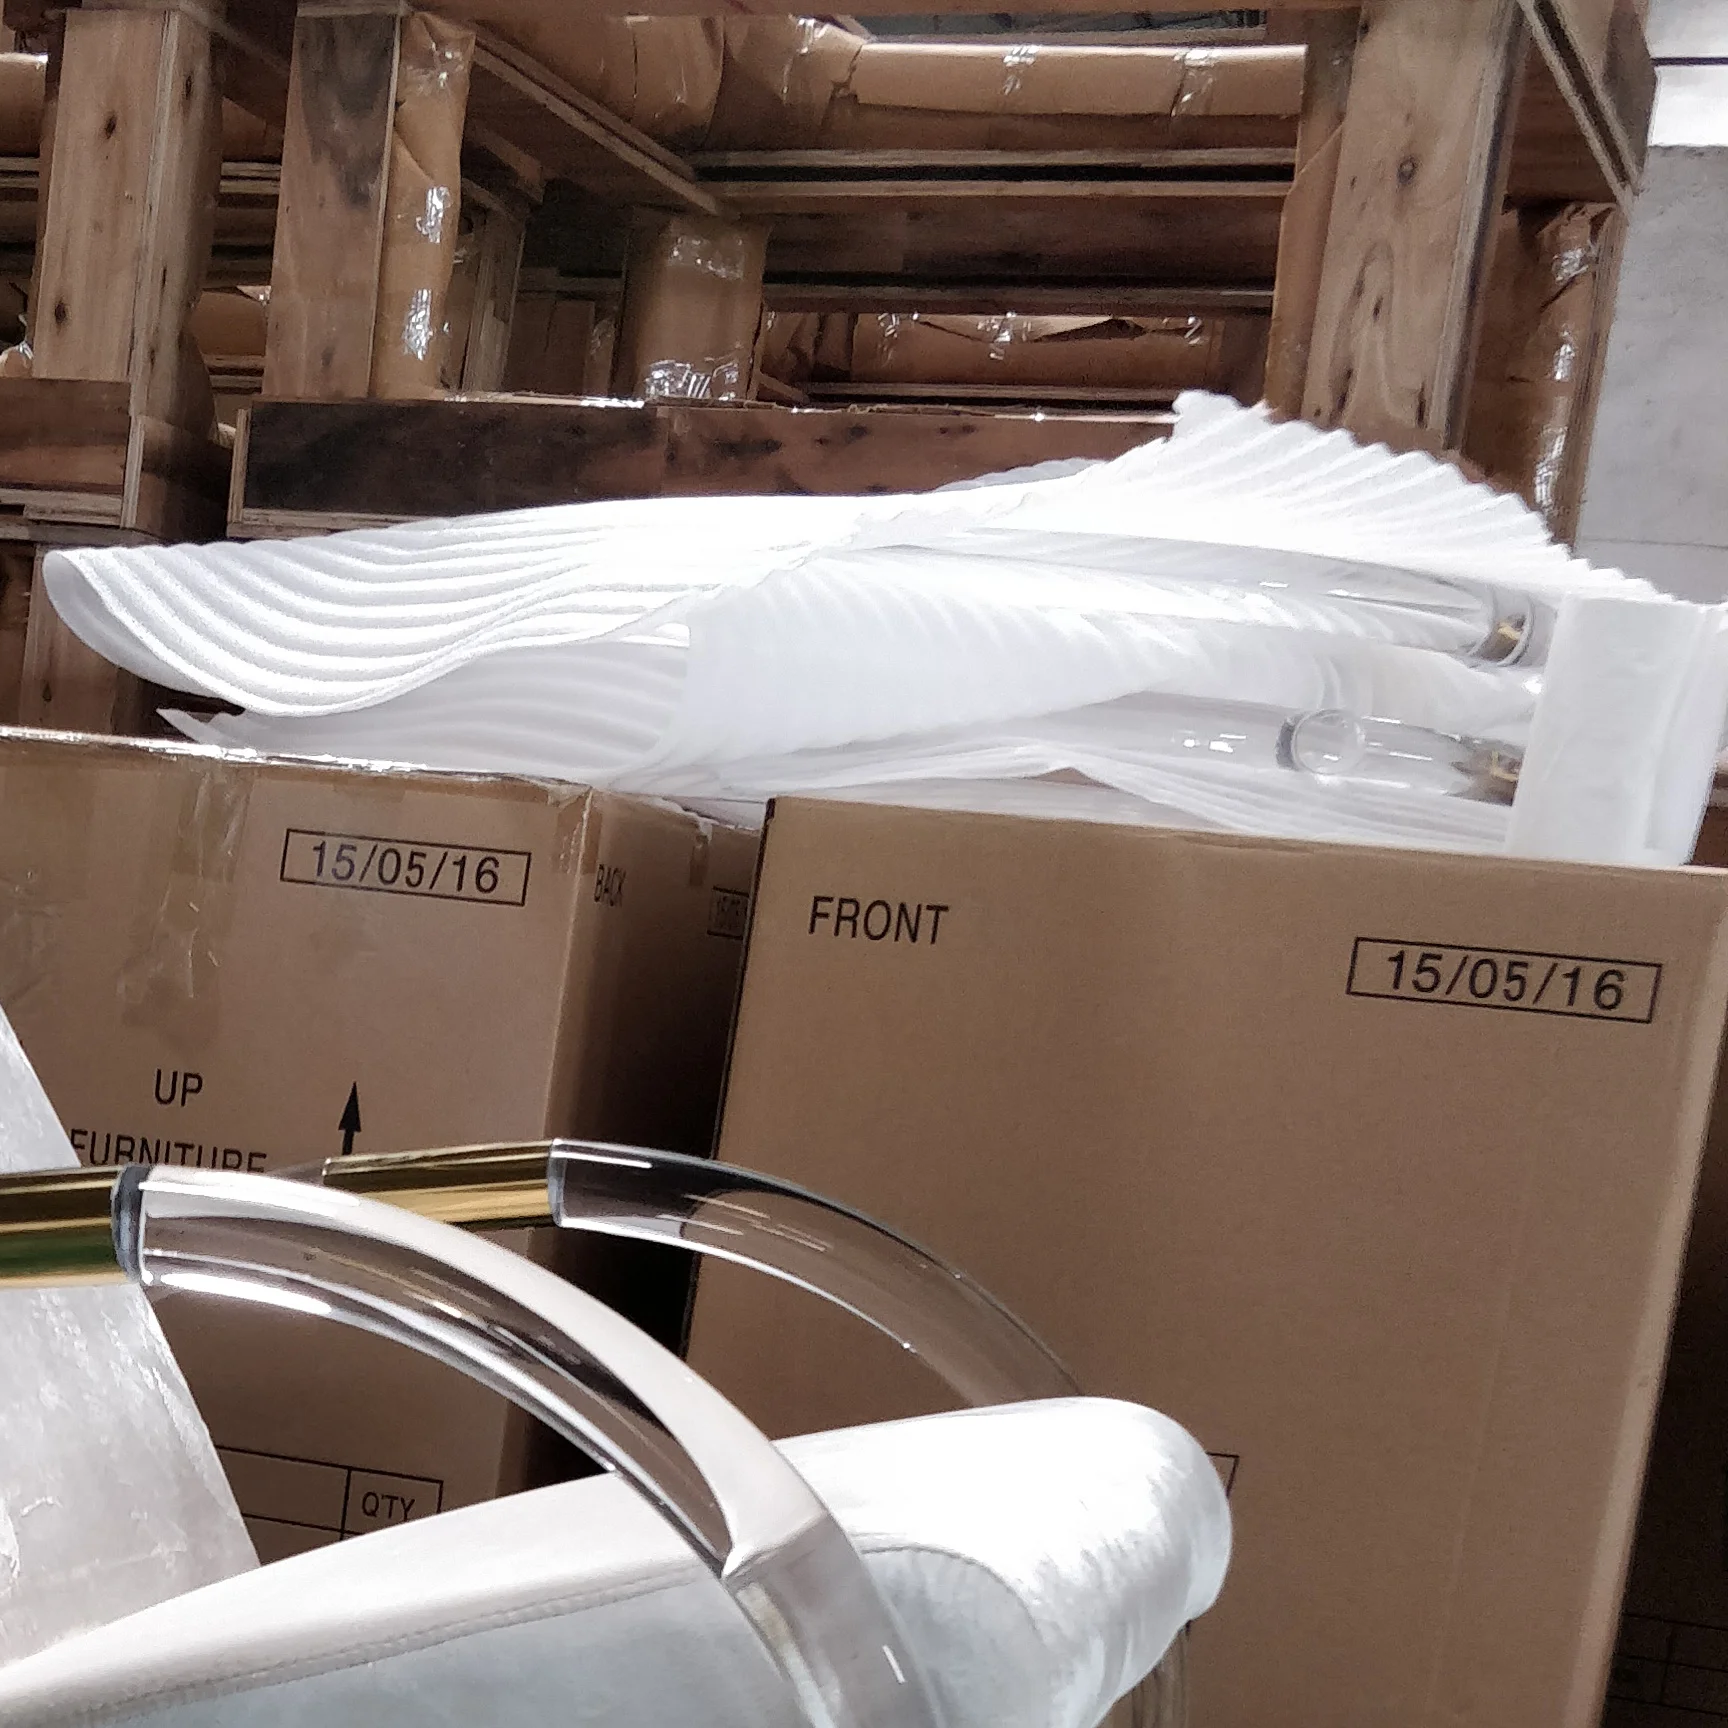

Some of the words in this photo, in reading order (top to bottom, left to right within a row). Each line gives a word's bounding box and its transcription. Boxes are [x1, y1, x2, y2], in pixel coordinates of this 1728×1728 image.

[312, 839, 501, 895] 15/05/16
[807, 894, 951, 946] FRONT
[1387, 949, 1626, 1012] 15/05/16
[153, 1067, 204, 1107] UP
[70, 1128, 268, 1174] FURNITURE
[361, 1490, 416, 1523] QTY
